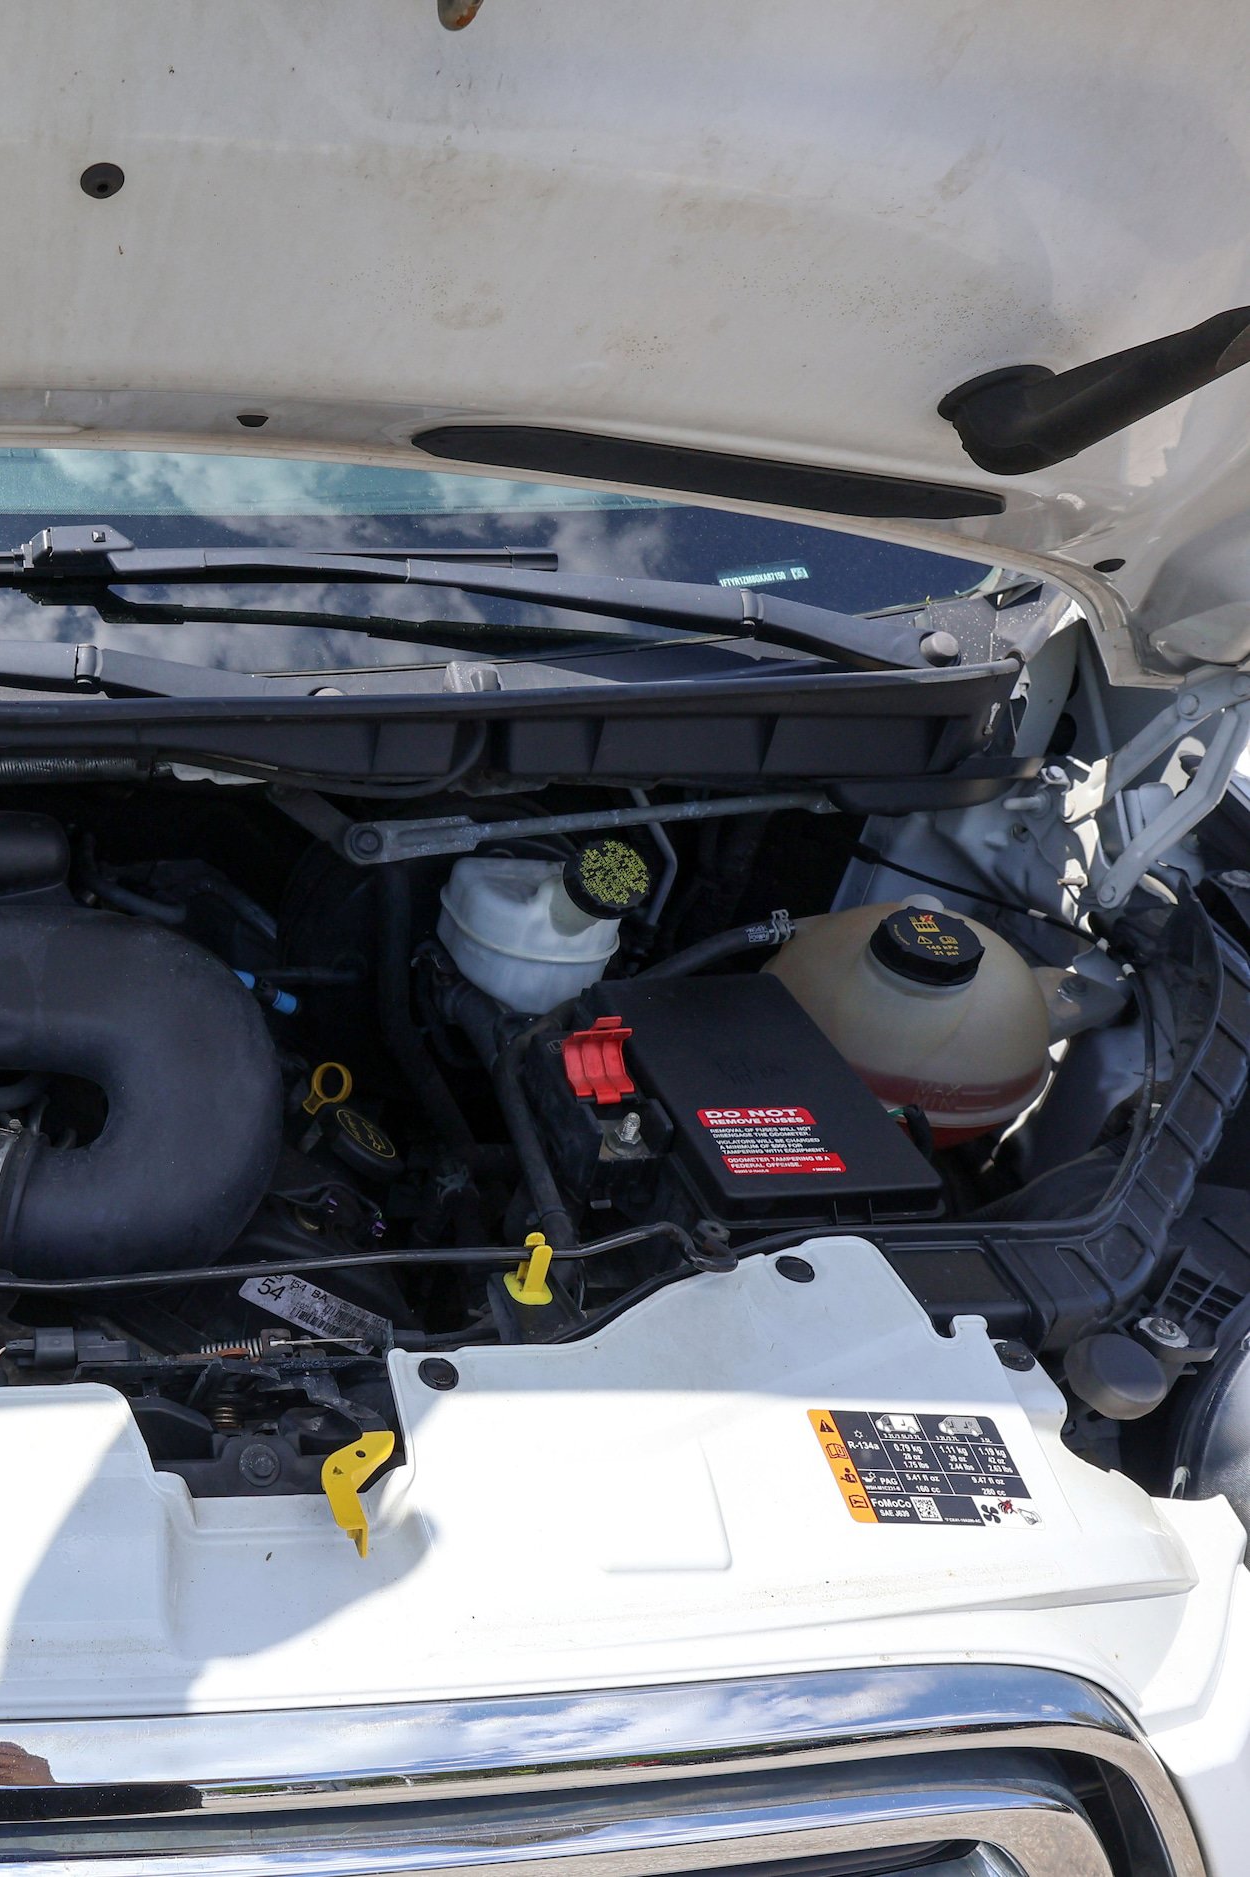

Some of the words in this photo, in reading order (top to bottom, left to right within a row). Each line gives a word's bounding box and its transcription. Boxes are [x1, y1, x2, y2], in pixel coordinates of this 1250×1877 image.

[704, 1110, 741, 1118] DO
[748, 1109, 798, 1118] NOT
[258, 1278, 286, 1301] 54
[290, 1279, 308, 1292] 154
[311, 1290, 328, 1303] BA
[847, 1441, 880, 1450] R-134a
[894, 1443, 911, 1452] 0.79
[911, 1444, 923, 1454] kg
[939, 1446, 956, 1454] 1.11
[956, 1446, 968, 1456] kg
[978, 1447, 995, 1456] 1.19
[995, 1448, 1007, 1458] kg
[917, 1461, 930, 1469] lbs
[963, 1463, 975, 1471] lbs
[880, 1477, 898, 1485] PAG
[870, 1498, 912, 1508] FoMoCo
